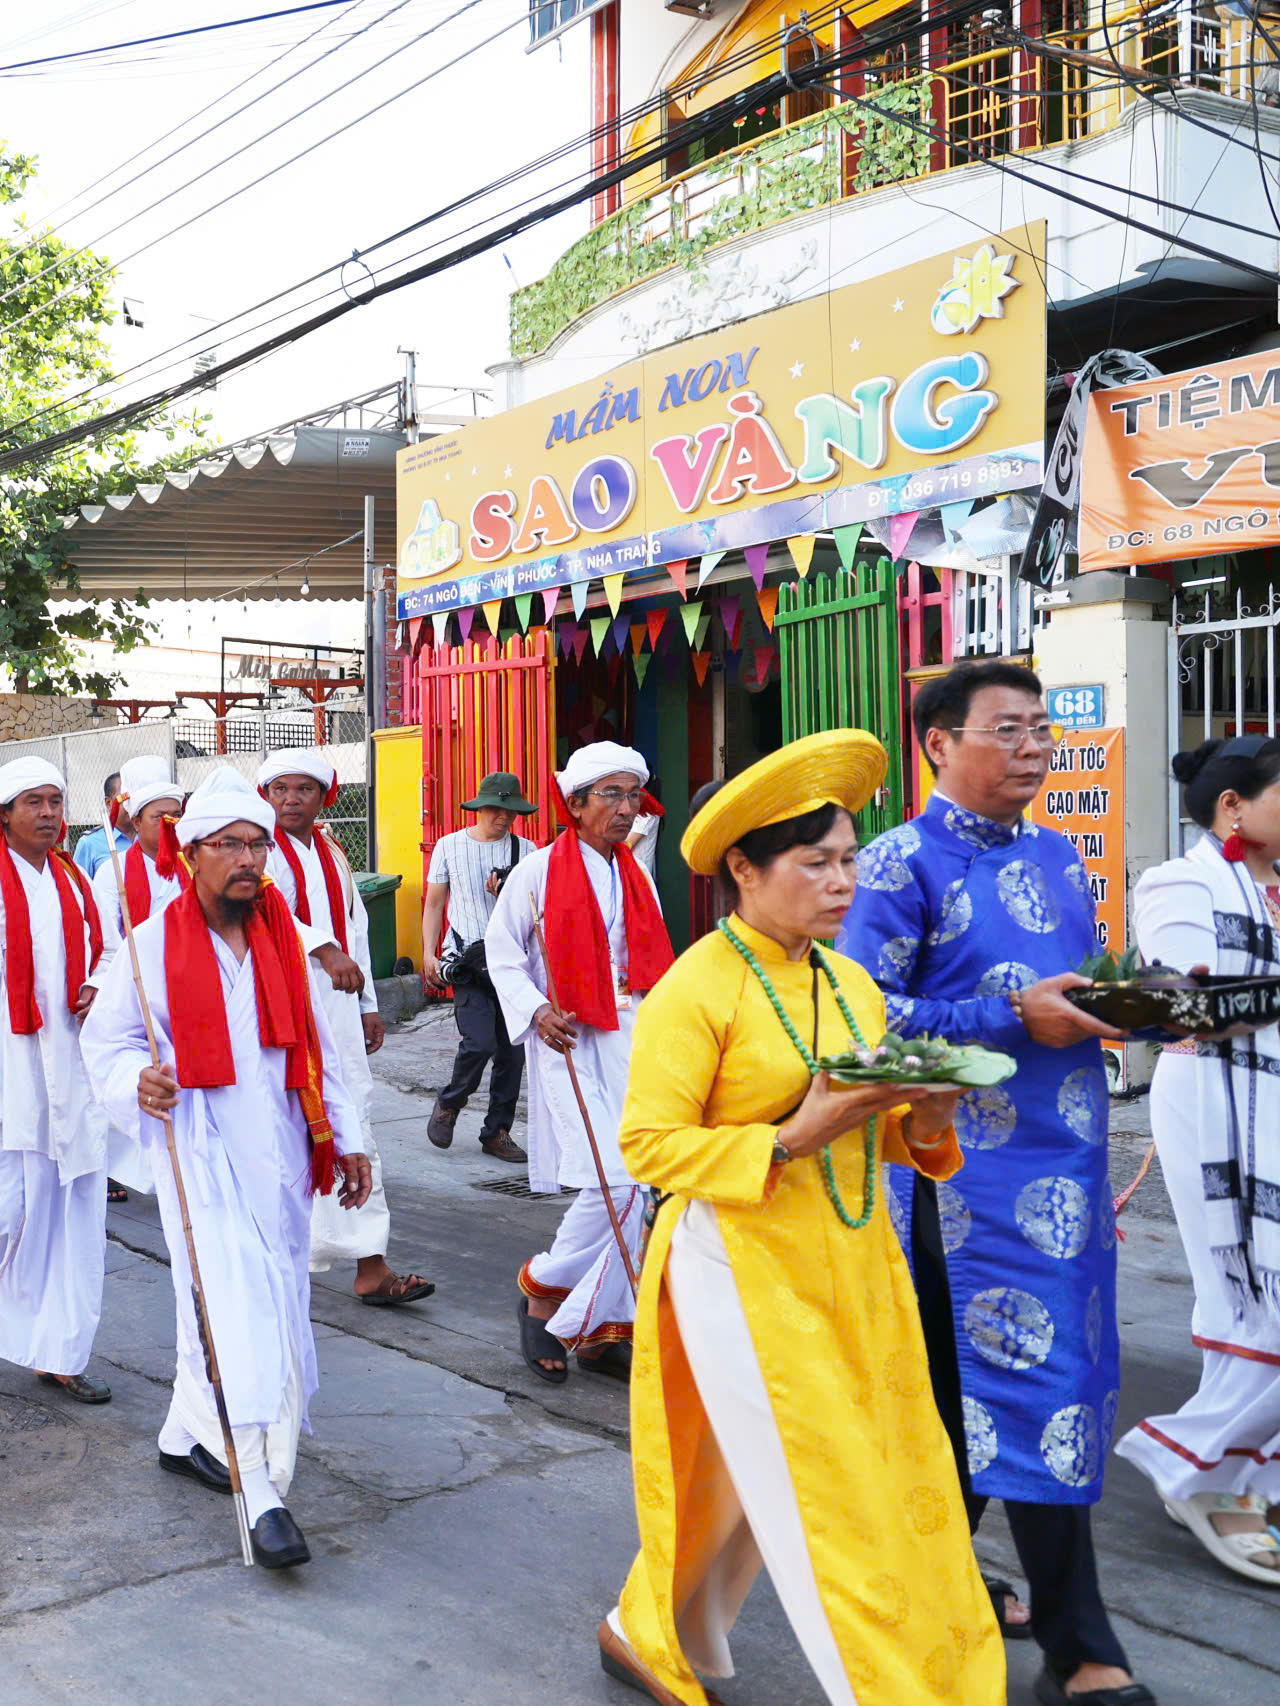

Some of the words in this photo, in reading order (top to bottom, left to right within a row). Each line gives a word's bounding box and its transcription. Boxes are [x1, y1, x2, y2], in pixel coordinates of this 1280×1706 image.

[545, 381, 641, 449] MẦM
[658, 346, 760, 412] NON
[470, 454, 636, 562] SAO
[651, 351, 999, 513] VÀNG
[902, 480, 934, 500] 036
[939, 471, 972, 491] 719
[1108, 531, 1153, 550] ĐC:
[1163, 524, 1193, 542] 68
[1204, 508, 1269, 536] NGÔ
[405, 594, 420, 610] ĐC:
[423, 592, 434, 604] 74
[433, 584, 458, 603] NGÔ
[587, 552, 613, 569] NHA
[229, 655, 272, 679] Min
[1055, 690, 1096, 716] 68
[1050, 740, 1075, 771] CẮT
[1079, 742, 1106, 771] TÓC
[1047, 791, 1074, 819] CẠO
[1078, 785, 1109, 819] MẶT
[1083, 834, 1103, 857] TAI
